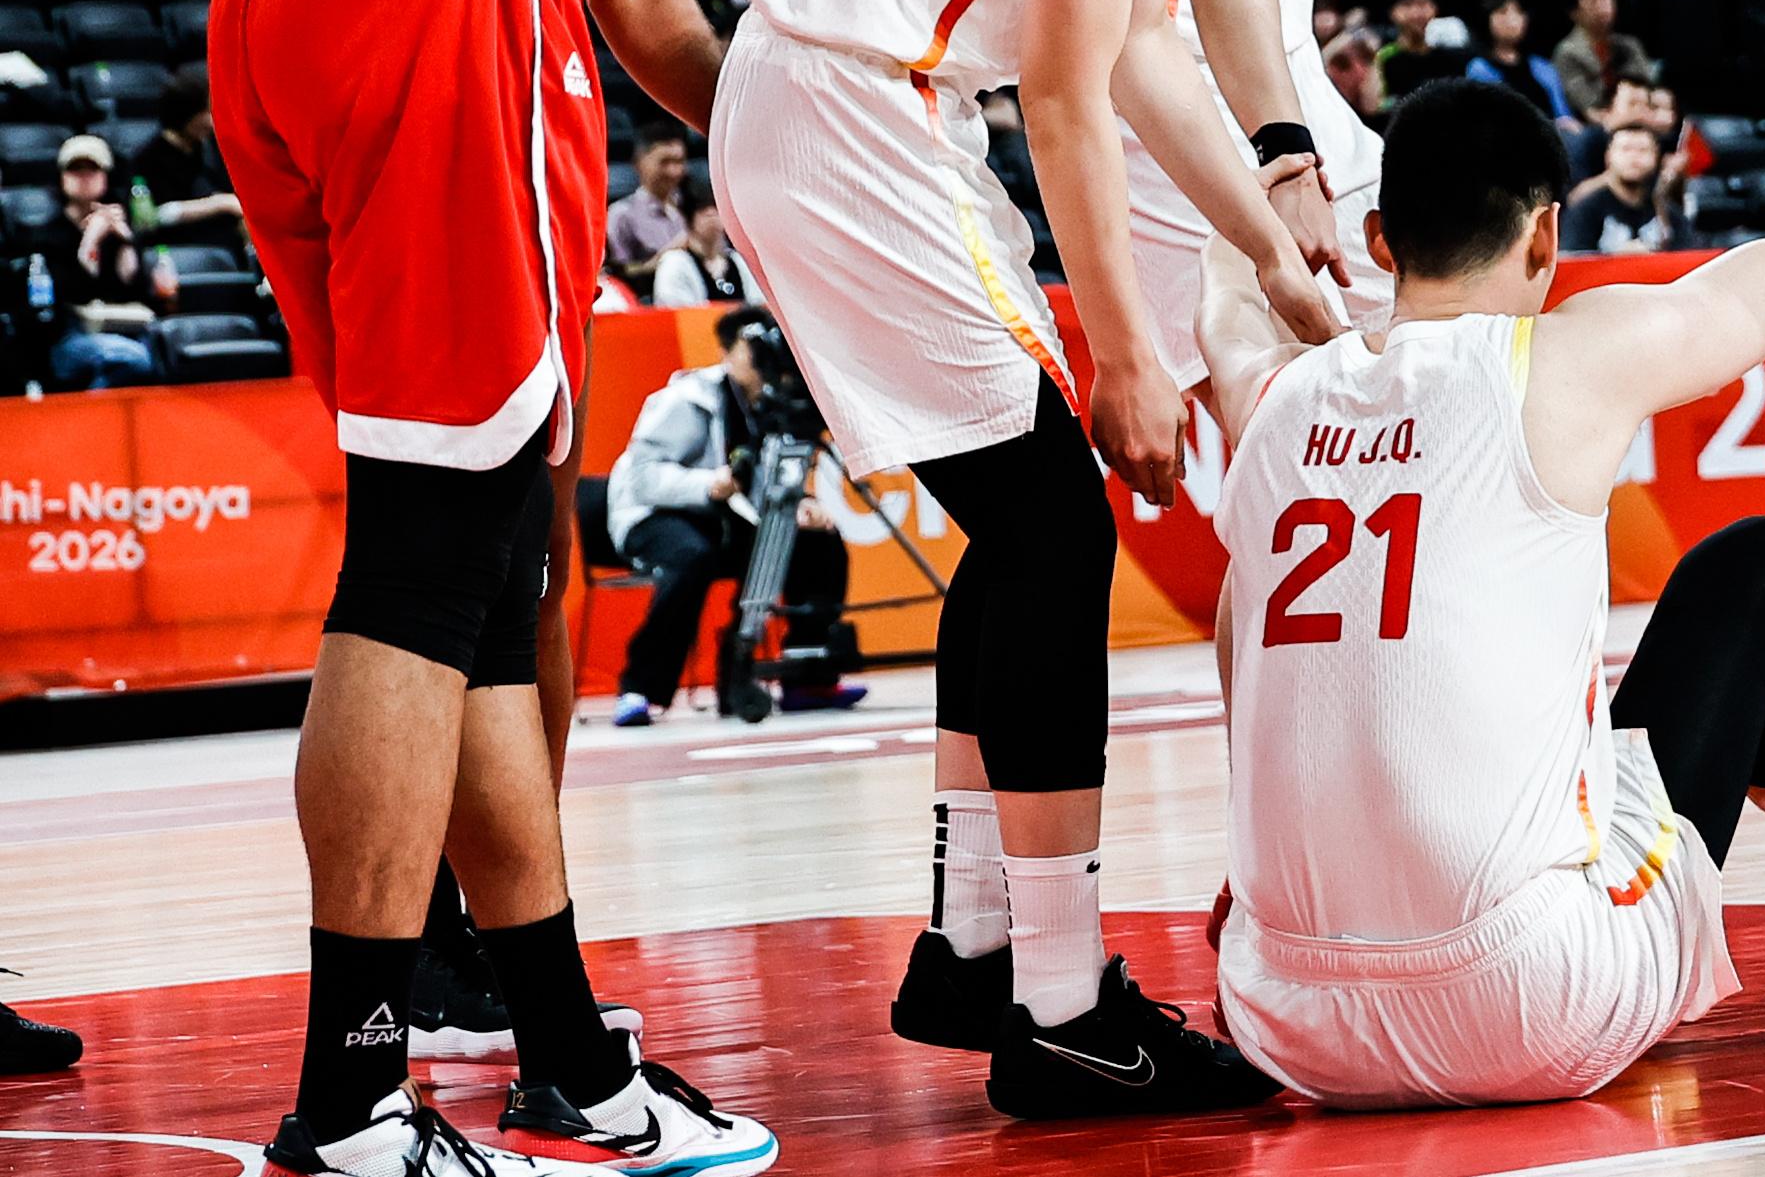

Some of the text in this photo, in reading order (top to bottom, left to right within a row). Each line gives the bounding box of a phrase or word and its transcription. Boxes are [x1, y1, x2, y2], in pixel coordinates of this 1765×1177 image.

[1303, 418, 1421, 466] HU J.Q.
[28, 528, 146, 572] 2026
[1262, 493, 1421, 648] 21
[345, 1027, 404, 1048] PEAK
